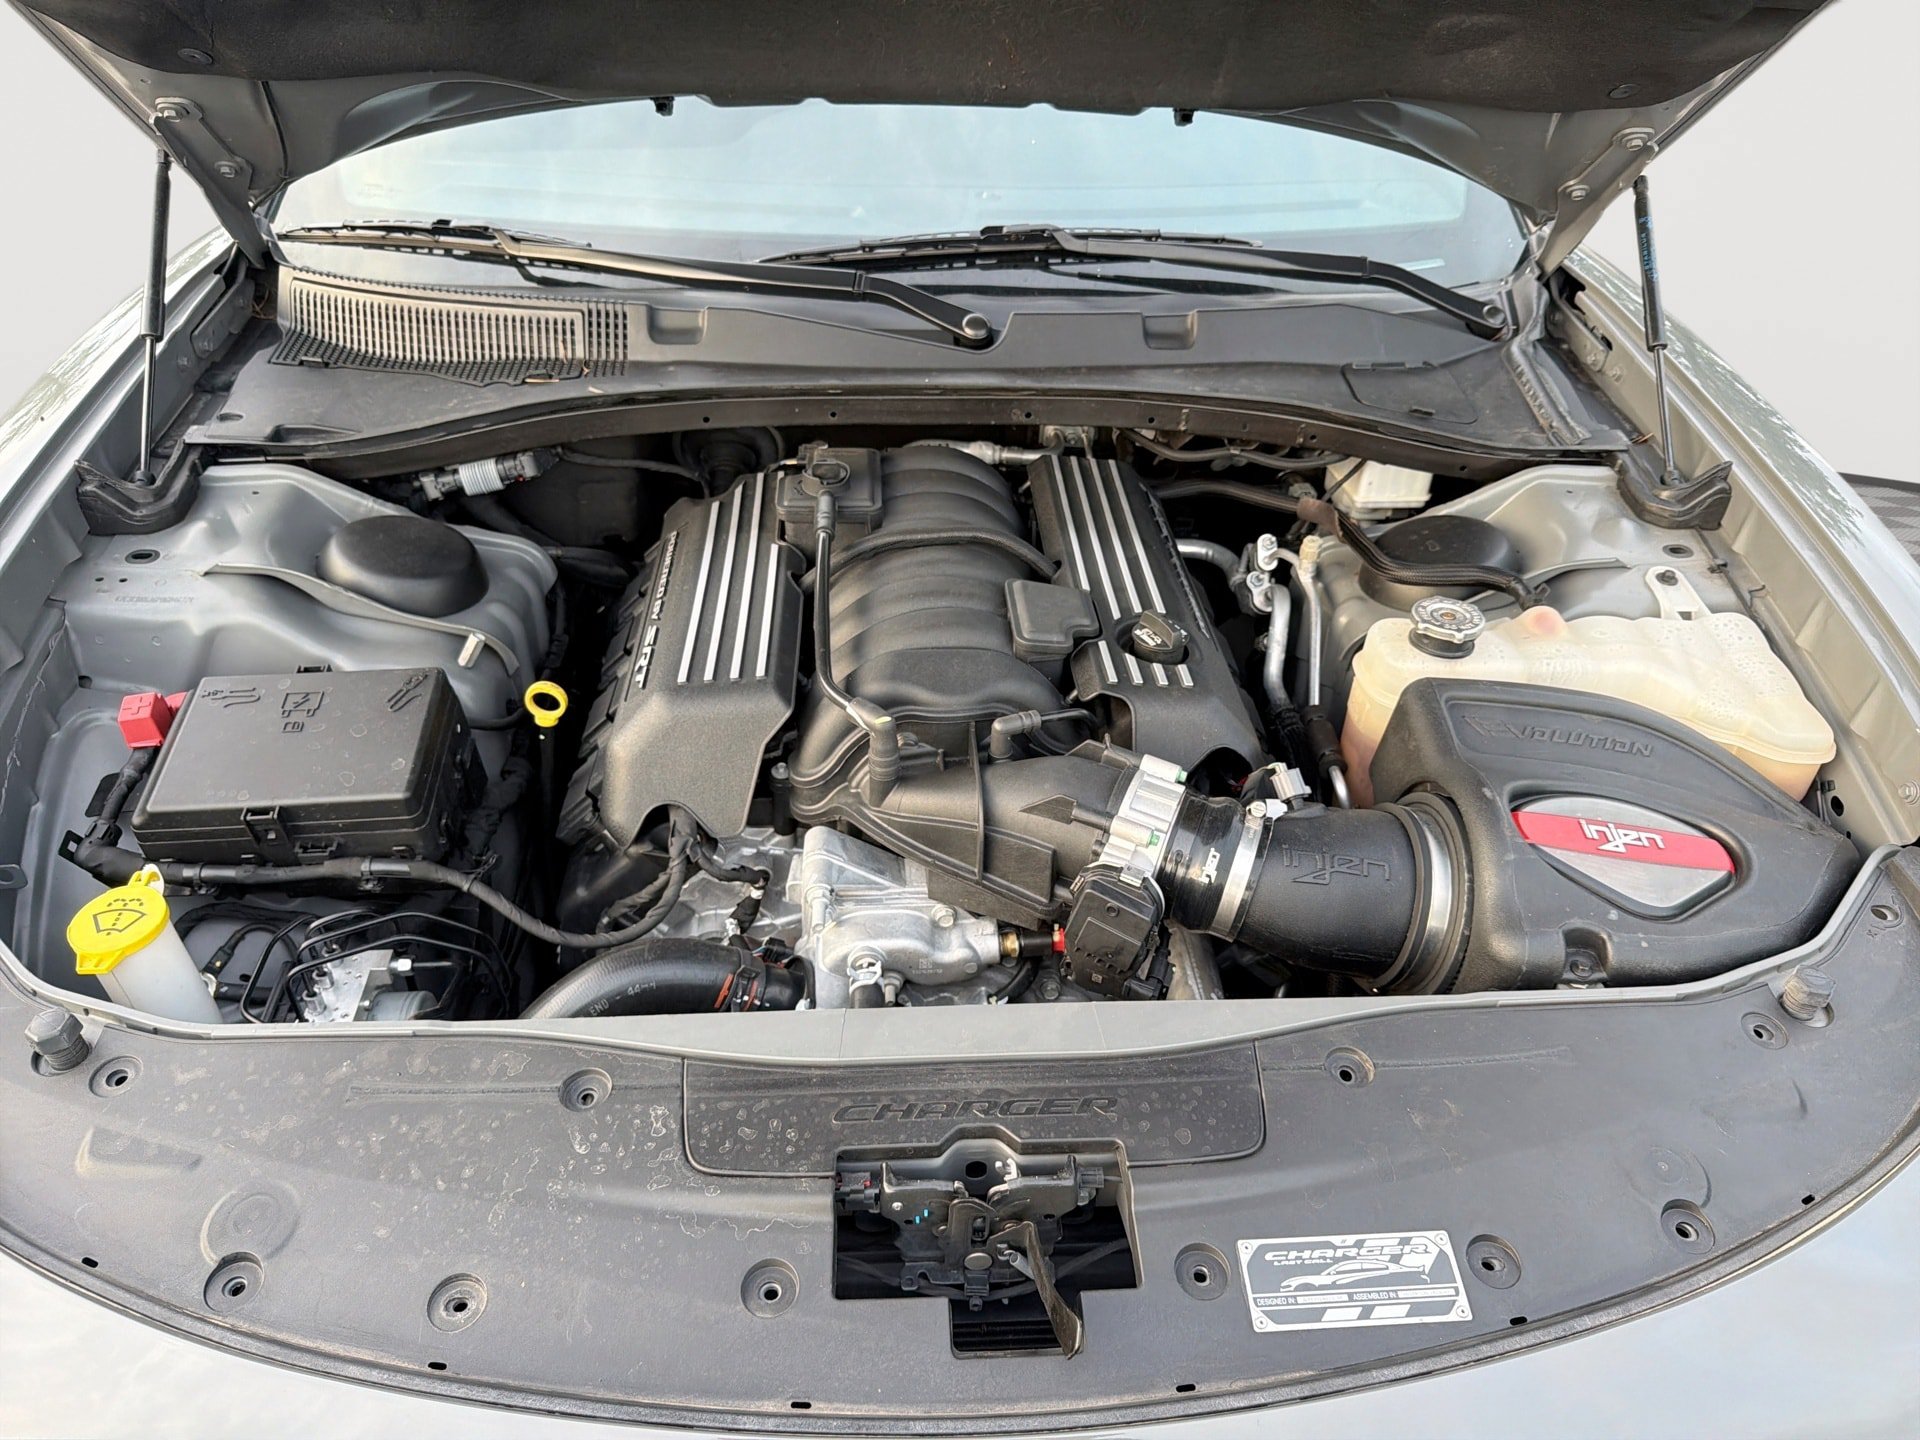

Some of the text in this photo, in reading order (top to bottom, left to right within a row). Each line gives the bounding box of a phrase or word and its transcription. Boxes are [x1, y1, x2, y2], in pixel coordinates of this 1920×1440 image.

[635, 531, 678, 690] POWERED BY SRT
[589, 999, 610, 1016] END
[832, 1097, 1119, 1124] CHARGER
[1264, 1243, 1431, 1262] CHARGER
[1256, 1297, 1287, 1306] DESIGNED
[1353, 1290, 1389, 1300] ASSEMBLED
